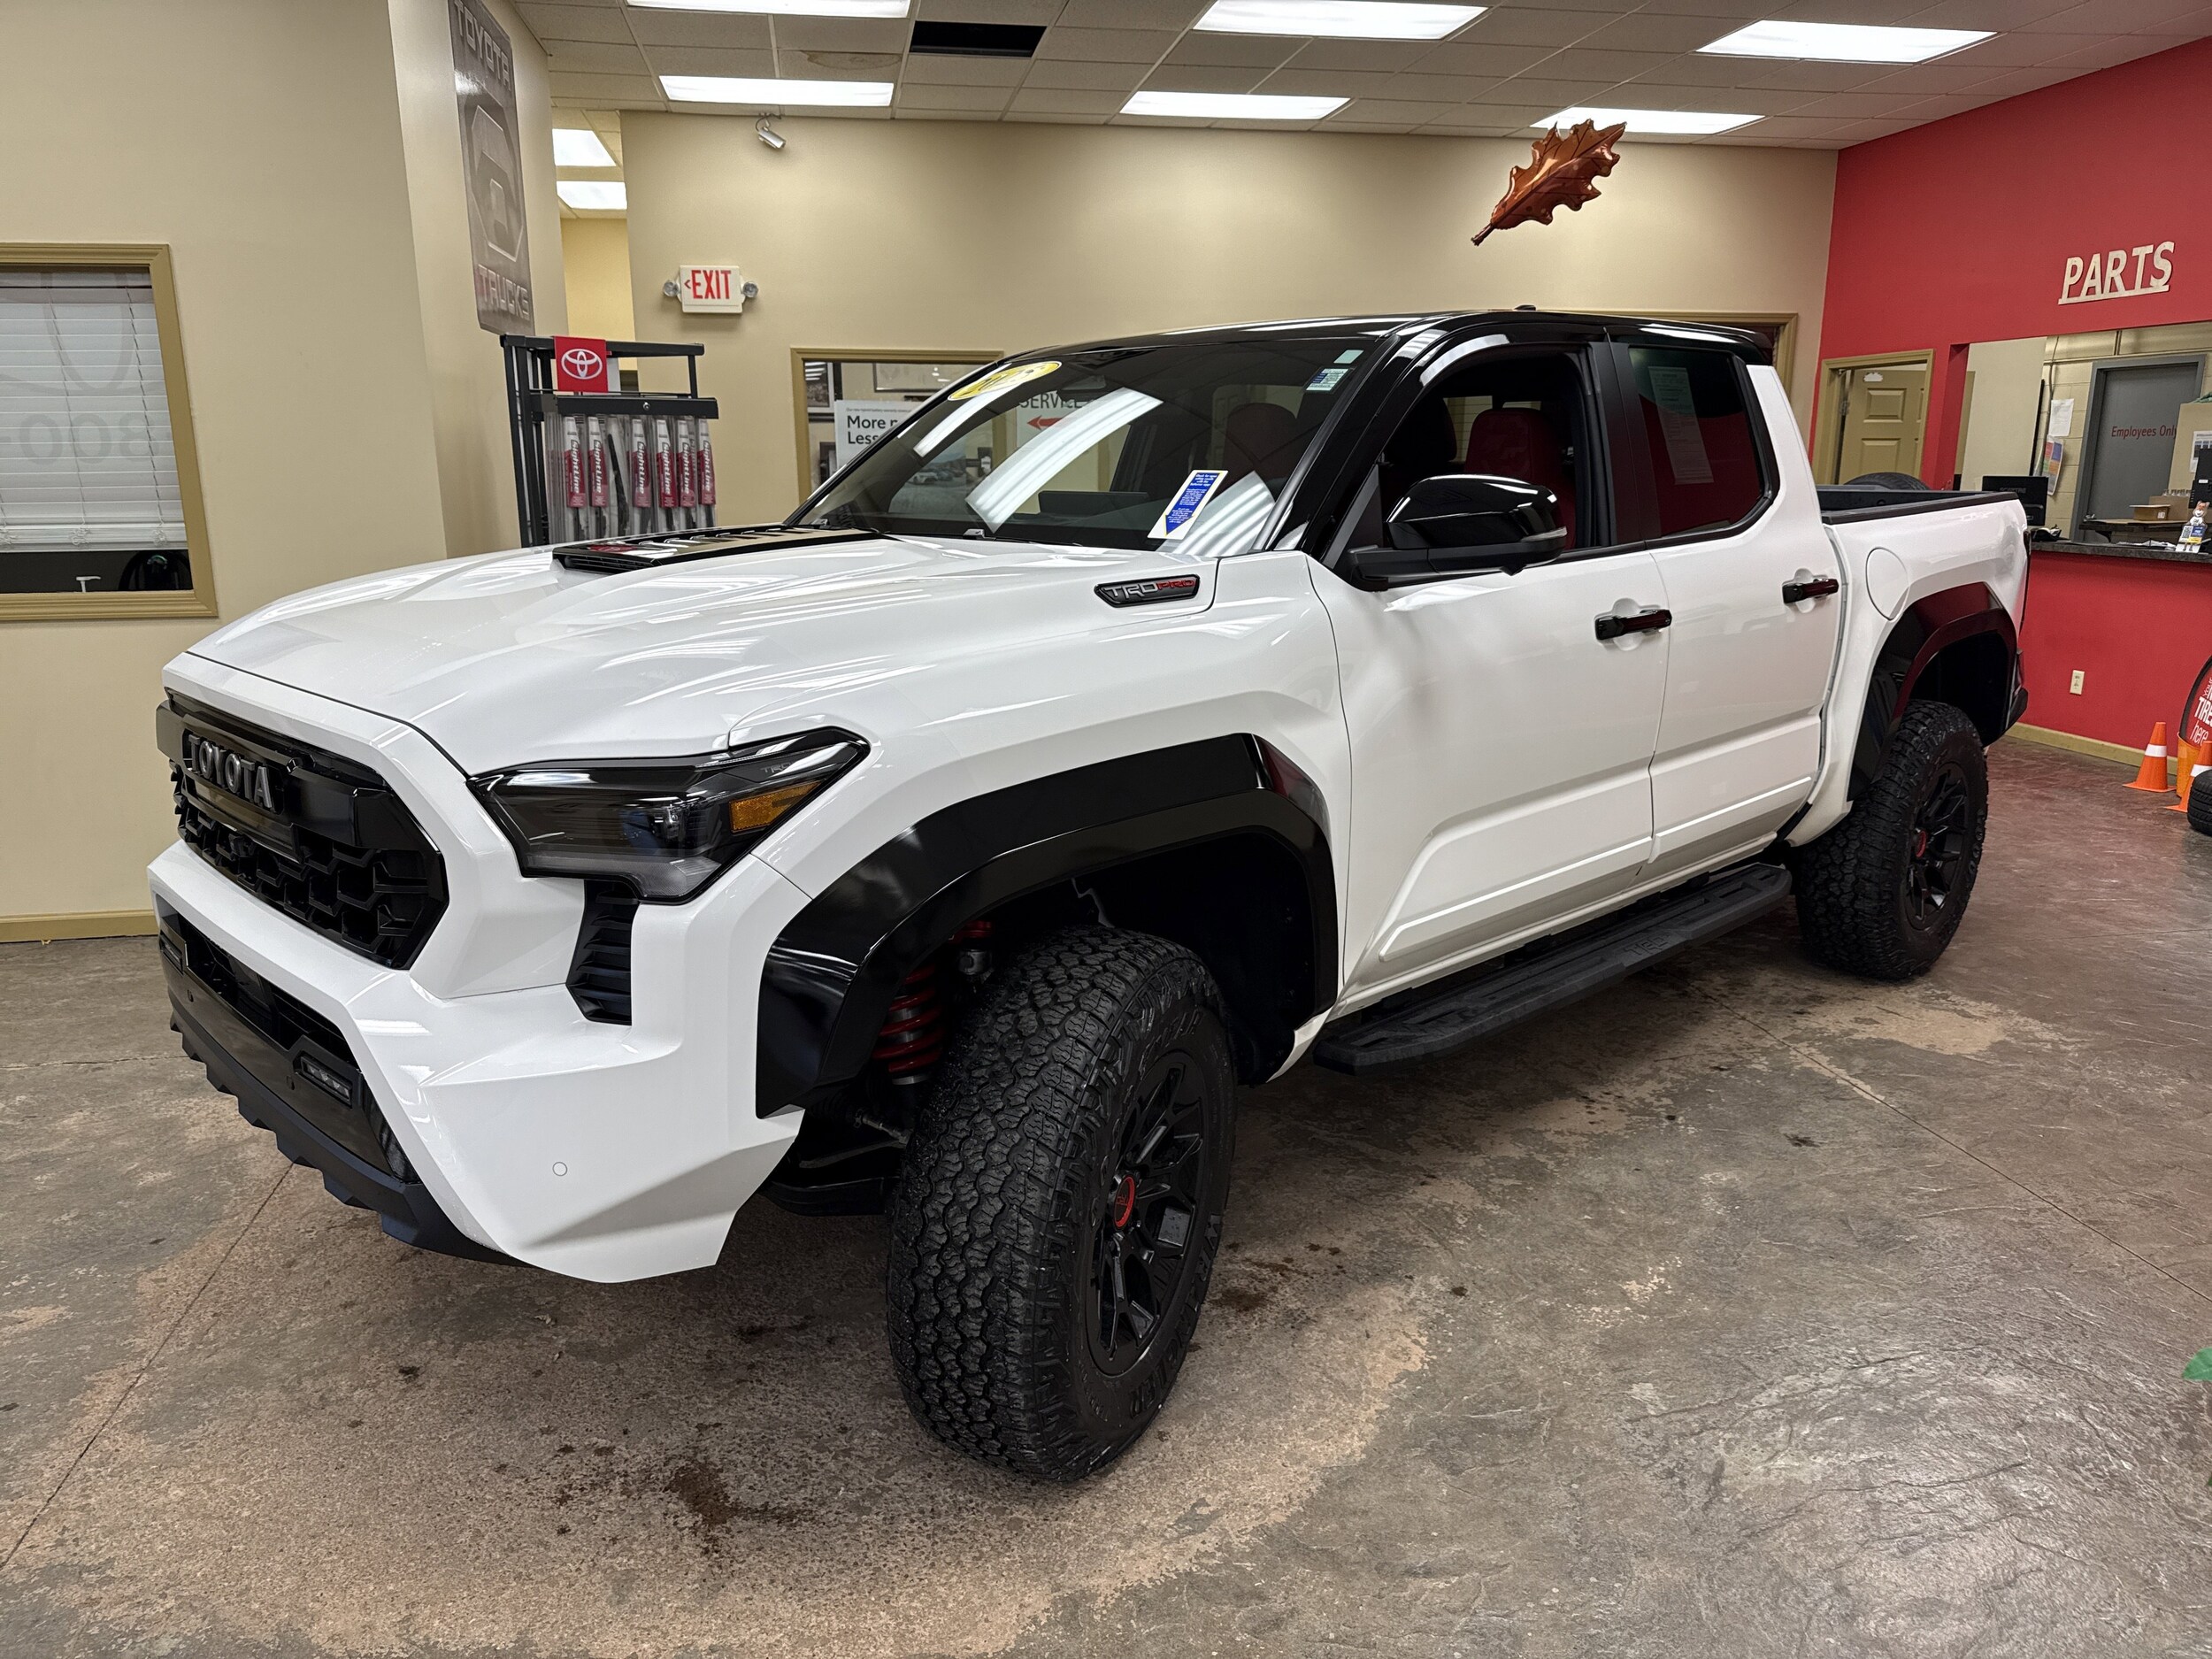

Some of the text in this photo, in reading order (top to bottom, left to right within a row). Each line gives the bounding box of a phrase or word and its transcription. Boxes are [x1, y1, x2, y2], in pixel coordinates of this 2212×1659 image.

[454, 0, 511, 91] TOYOTA
[478, 264, 530, 320] TRUCKS
[691, 270, 732, 299] EXIT
[2060, 241, 2175, 303] PARTS
[847, 415, 886, 429] More
[2111, 426, 2157, 440] Employees
[1104, 579, 1195, 599] TRD PRO
[188, 734, 273, 810] TOYOTA
[1130, 1213, 1223, 1418] WRANGLER
